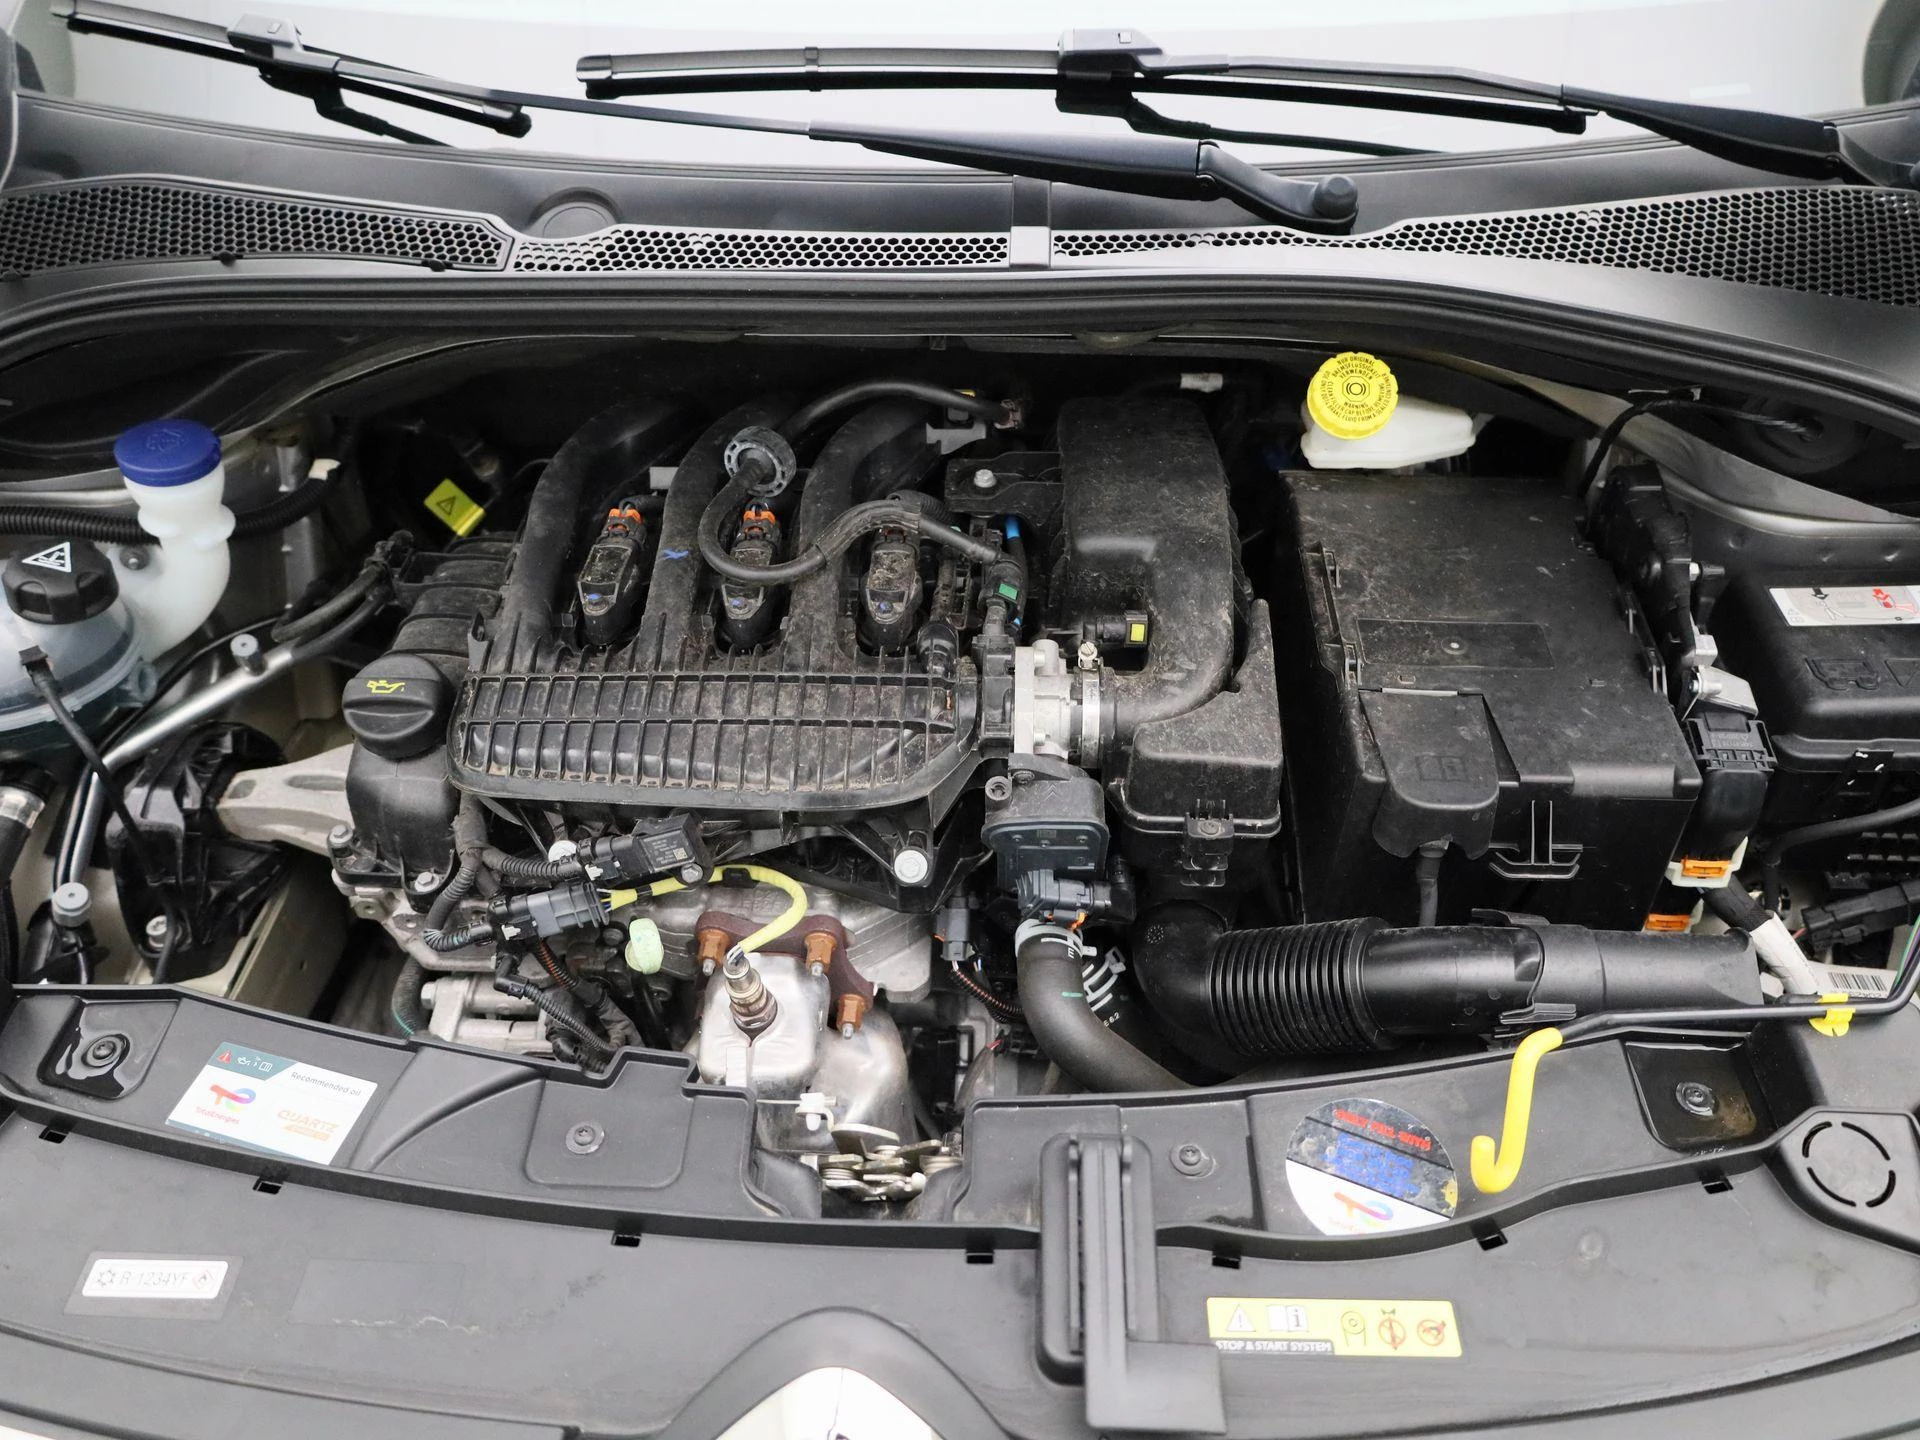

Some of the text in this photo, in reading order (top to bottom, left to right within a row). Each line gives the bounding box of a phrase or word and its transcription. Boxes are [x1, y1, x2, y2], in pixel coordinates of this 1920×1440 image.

[1337, 356, 1375, 366] NUR ORIGINAL
[1339, 369, 1373, 380] VERWENDEN
[1342, 414, 1356, 422] FLUID
[1357, 414, 1372, 422] FROM
[291, 1071, 362, 1096] Recommended oil
[277, 1109, 339, 1133] QUARTZ
[1215, 1339, 1245, 1350] STOP
[1254, 1340, 1289, 1351] START
[1290, 1341, 1332, 1352] SYSTEM
